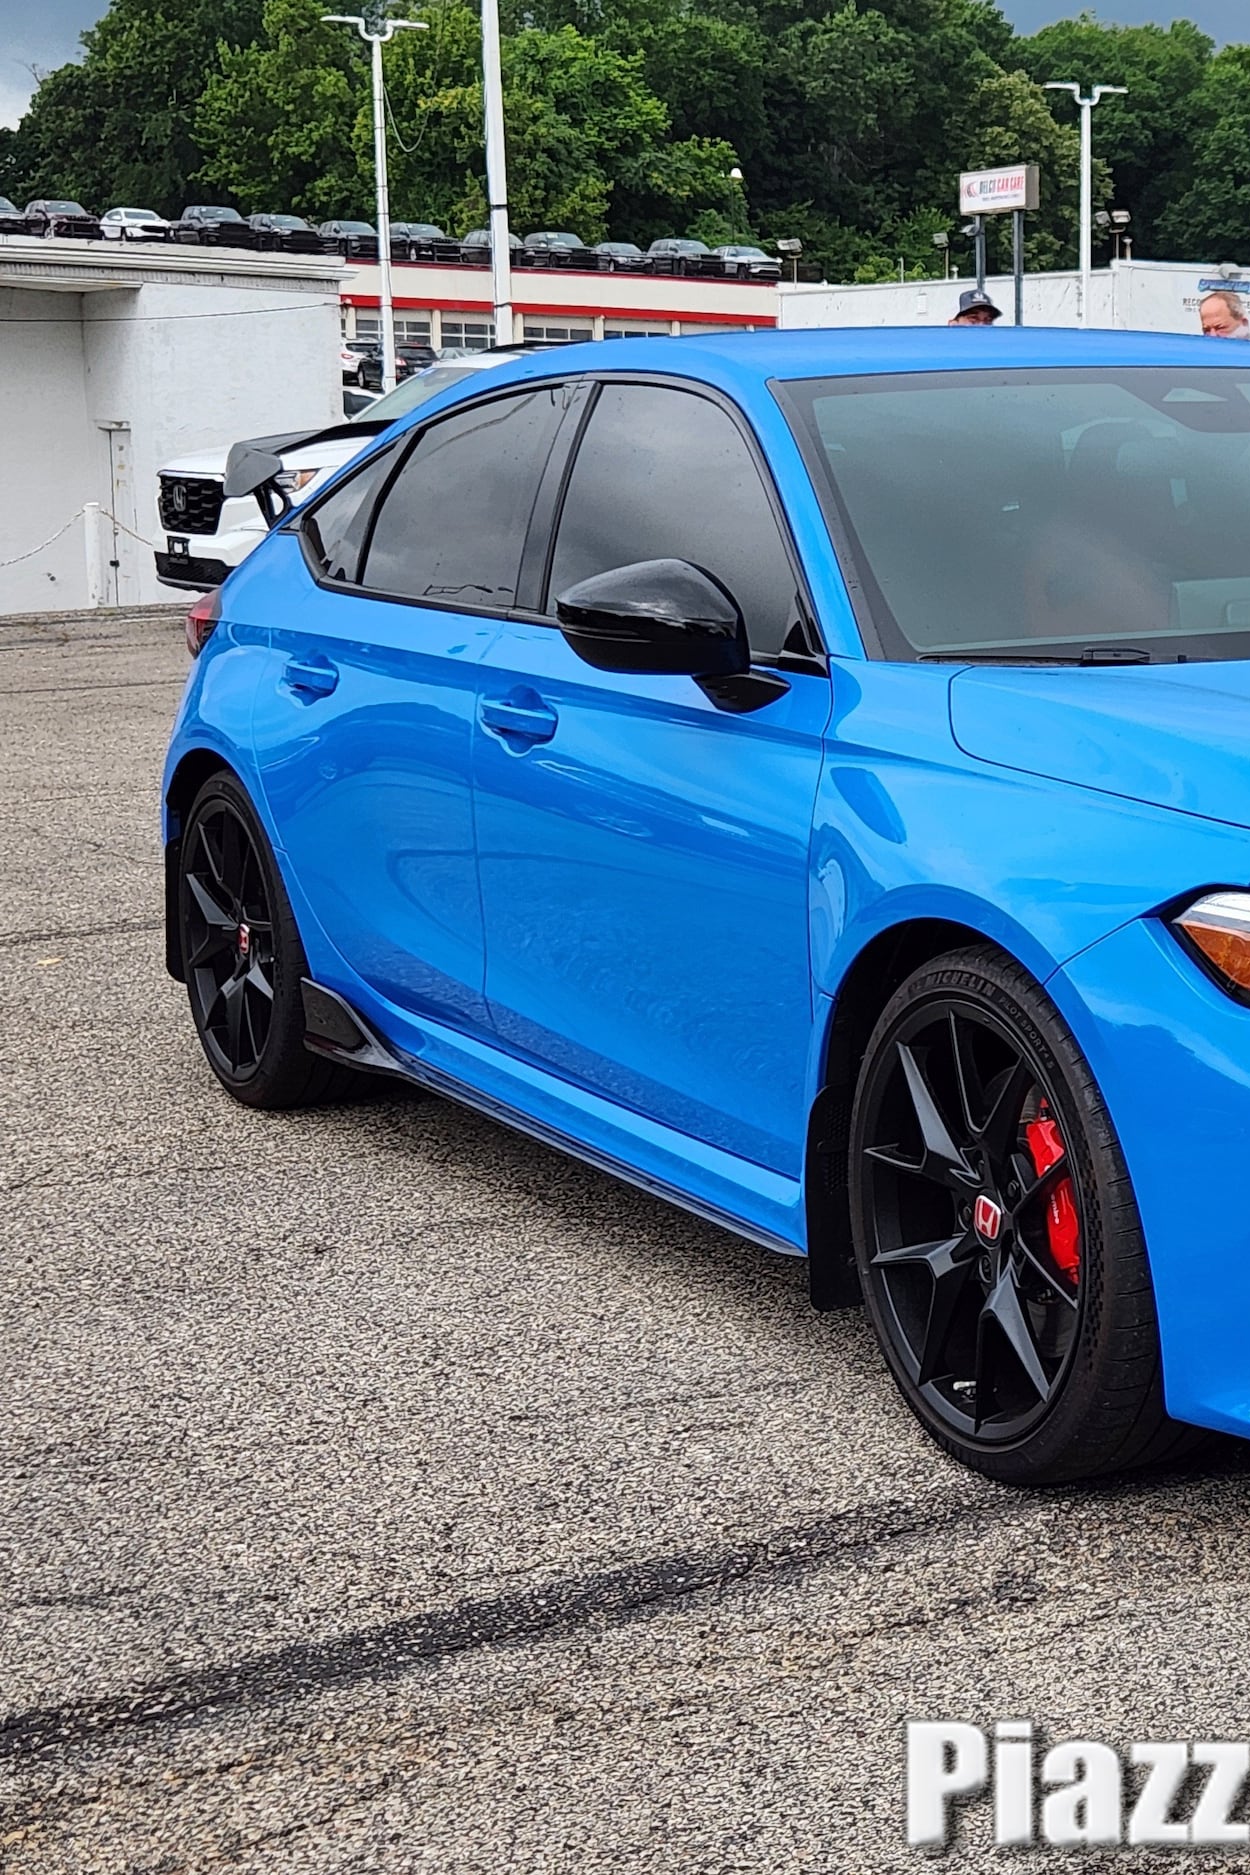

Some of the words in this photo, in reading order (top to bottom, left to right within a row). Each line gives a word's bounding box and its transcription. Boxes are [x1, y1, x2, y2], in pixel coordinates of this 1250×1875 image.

[925, 970, 997, 998] MICHELIN
[998, 996, 1022, 1020] PILOT
[1021, 1019, 1047, 1055] SPORT
